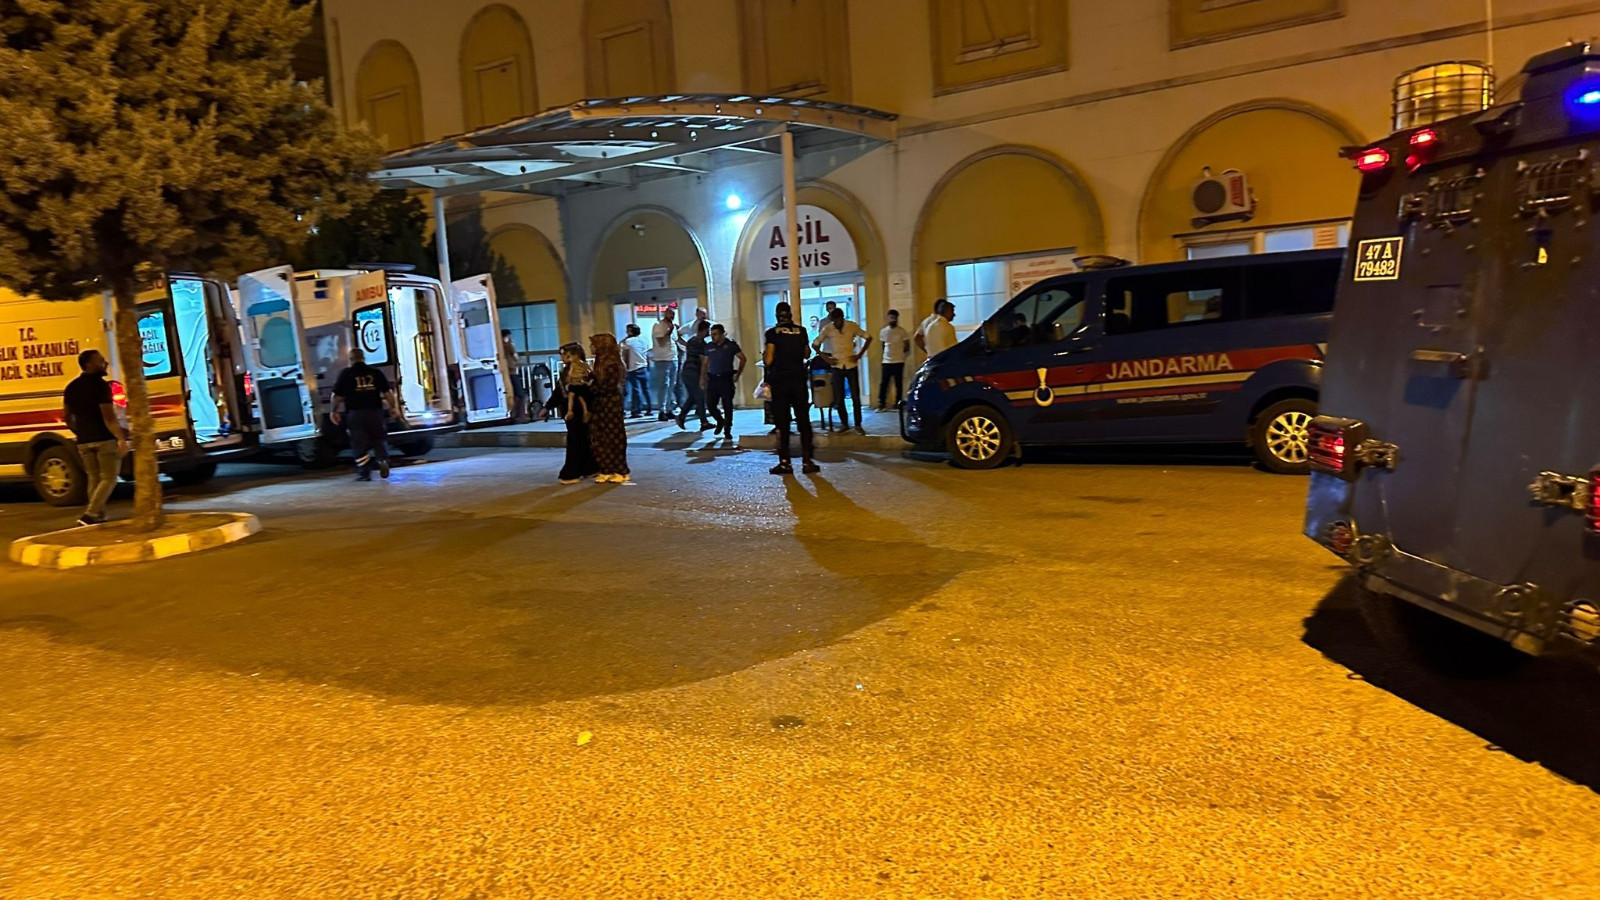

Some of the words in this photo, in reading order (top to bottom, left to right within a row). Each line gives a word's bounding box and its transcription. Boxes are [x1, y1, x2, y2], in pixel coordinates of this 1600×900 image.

[770, 248, 831, 271] SEVİS
[1365, 244, 1382, 260] 47
[1381, 242, 1393, 259] A
[1360, 259, 1396, 277] 79482
[365, 329, 380, 343] 112
[0, 346, 18, 361] LIK
[23, 338, 80, 360] BAKANLIĞI
[1, 363, 23, 381] ACİL
[26, 360, 65, 379] SAĞLIK
[1106, 353, 1234, 380] JANDARMA
[355, 375, 375, 388] 112
